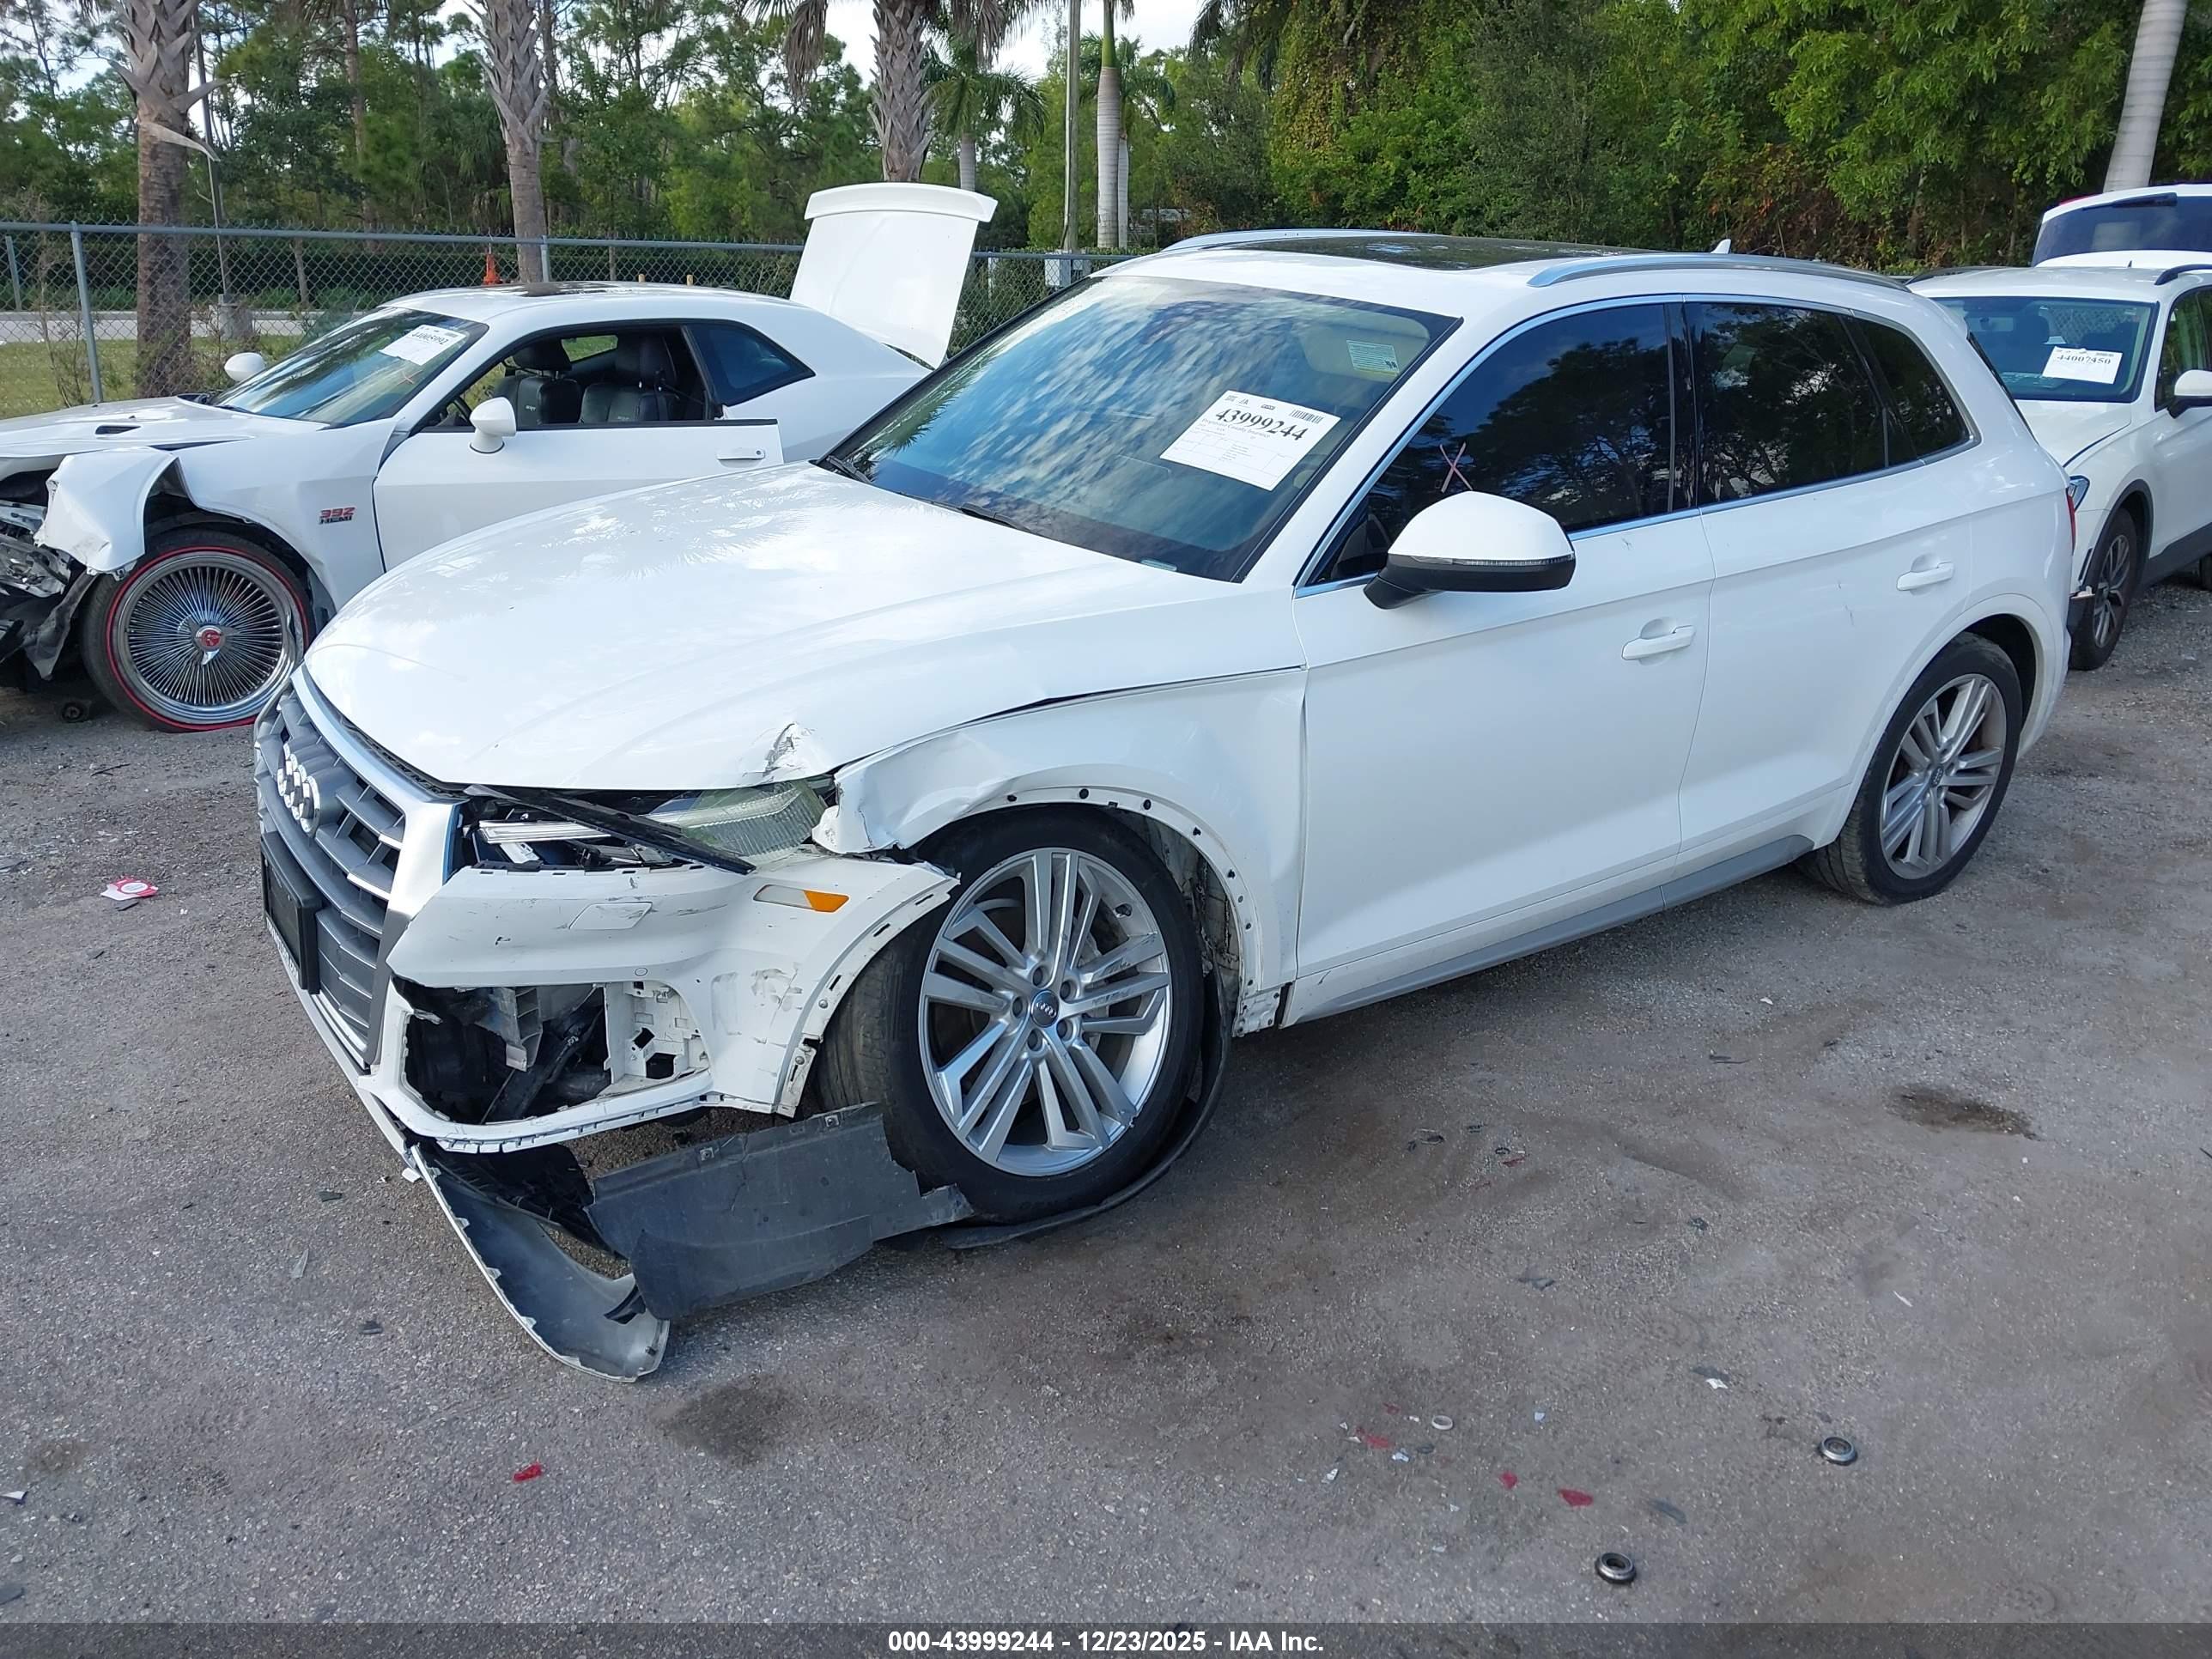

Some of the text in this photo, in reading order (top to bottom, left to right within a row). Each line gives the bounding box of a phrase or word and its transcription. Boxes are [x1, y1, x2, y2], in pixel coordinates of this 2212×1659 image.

[2057, 355, 2112, 365] 44007450
[1215, 408, 1309, 441] 43999244
[320, 507, 356, 519] 392
